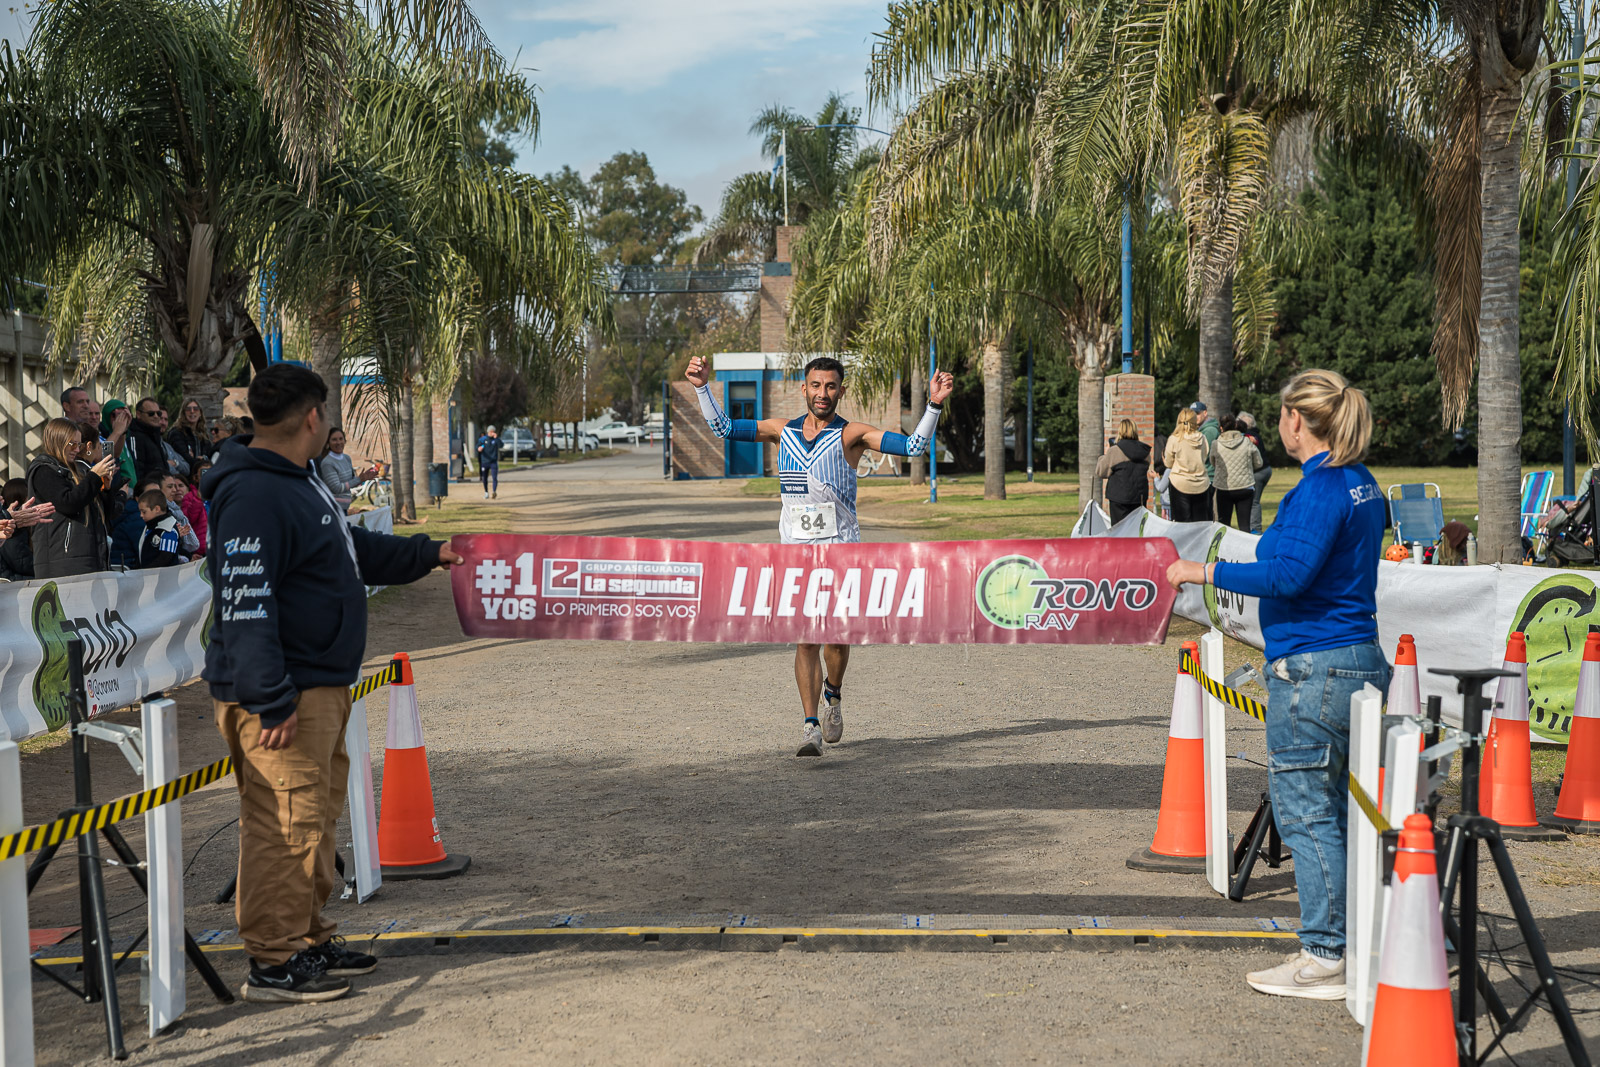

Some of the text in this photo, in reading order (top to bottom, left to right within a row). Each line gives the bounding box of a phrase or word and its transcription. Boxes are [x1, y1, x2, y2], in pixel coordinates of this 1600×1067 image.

[801, 513, 826, 531] 84
[229, 559, 265, 582] pueblo
[475, 552, 537, 596] #1
[585, 563, 696, 574] GRUPO ASEGURADOR
[234, 581, 272, 605] grande
[608, 577, 696, 596] segunda
[726, 566, 926, 618] LLEGADA
[481, 597, 537, 621] VOS
[545, 603, 697, 619] LO PRIMERO SOS VOS
[1024, 613, 1080, 630] RAV
